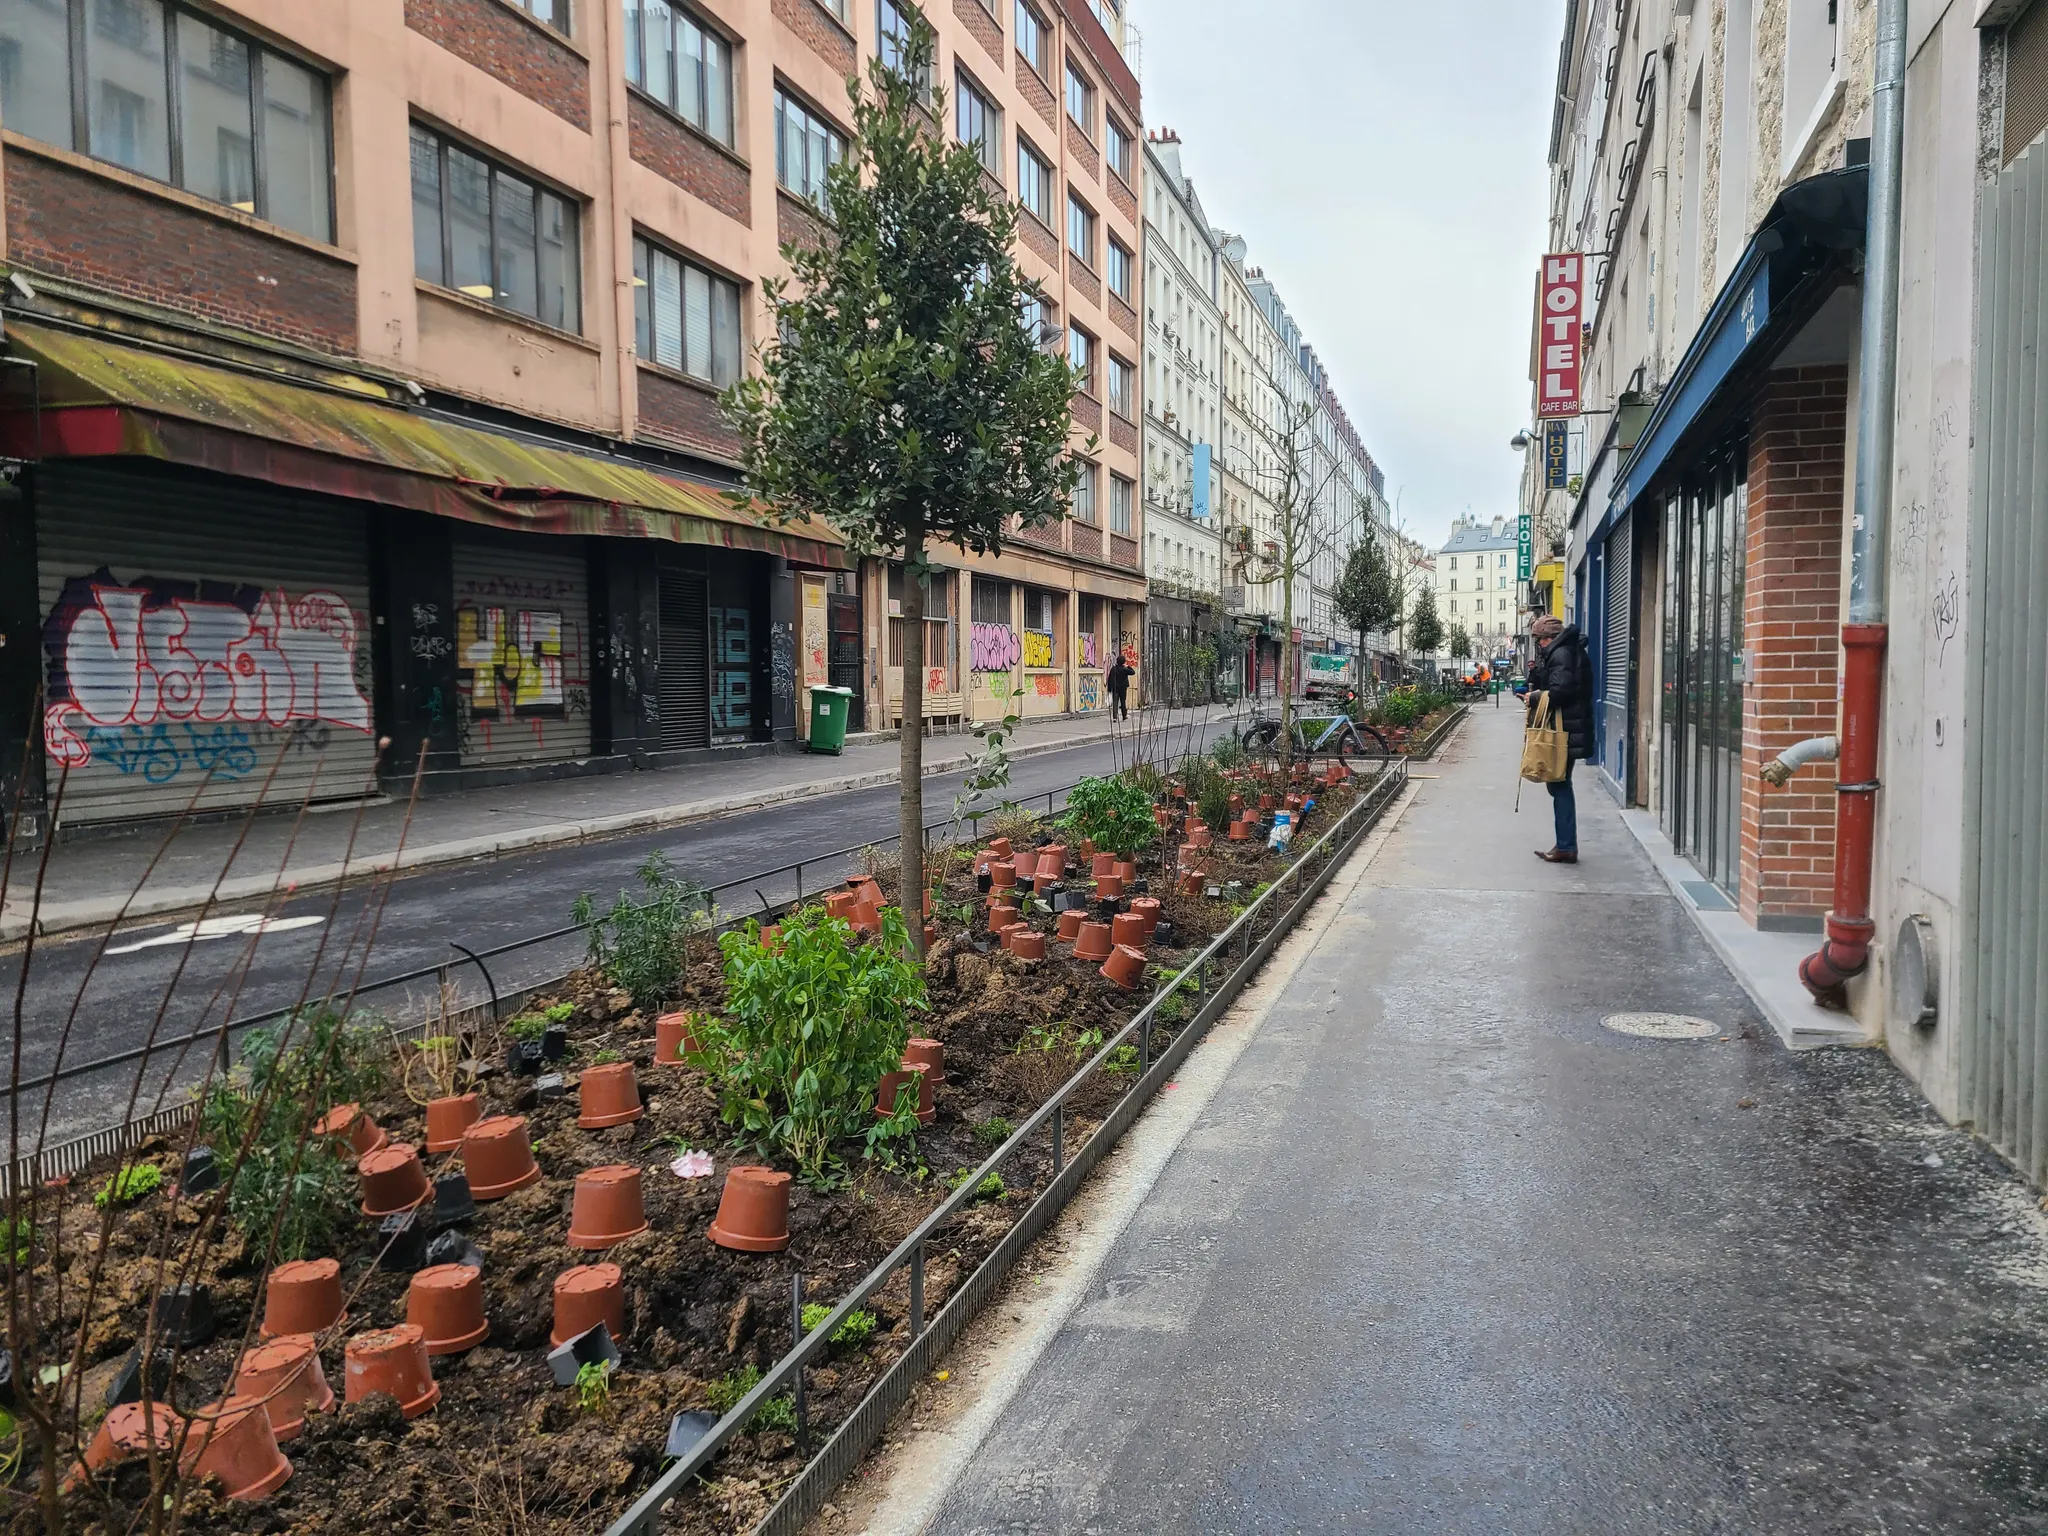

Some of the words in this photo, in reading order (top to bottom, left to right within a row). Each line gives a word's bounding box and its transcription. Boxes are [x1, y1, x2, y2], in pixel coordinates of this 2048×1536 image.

[1546, 257, 1578, 398] HOTEL
[1540, 402, 1560, 412] CAFE
[1562, 400, 1578, 411] BAR
[1547, 421, 1569, 432] MAX
[1549, 435, 1564, 489] HOTEL
[1519, 517, 1531, 579] HOTEL
